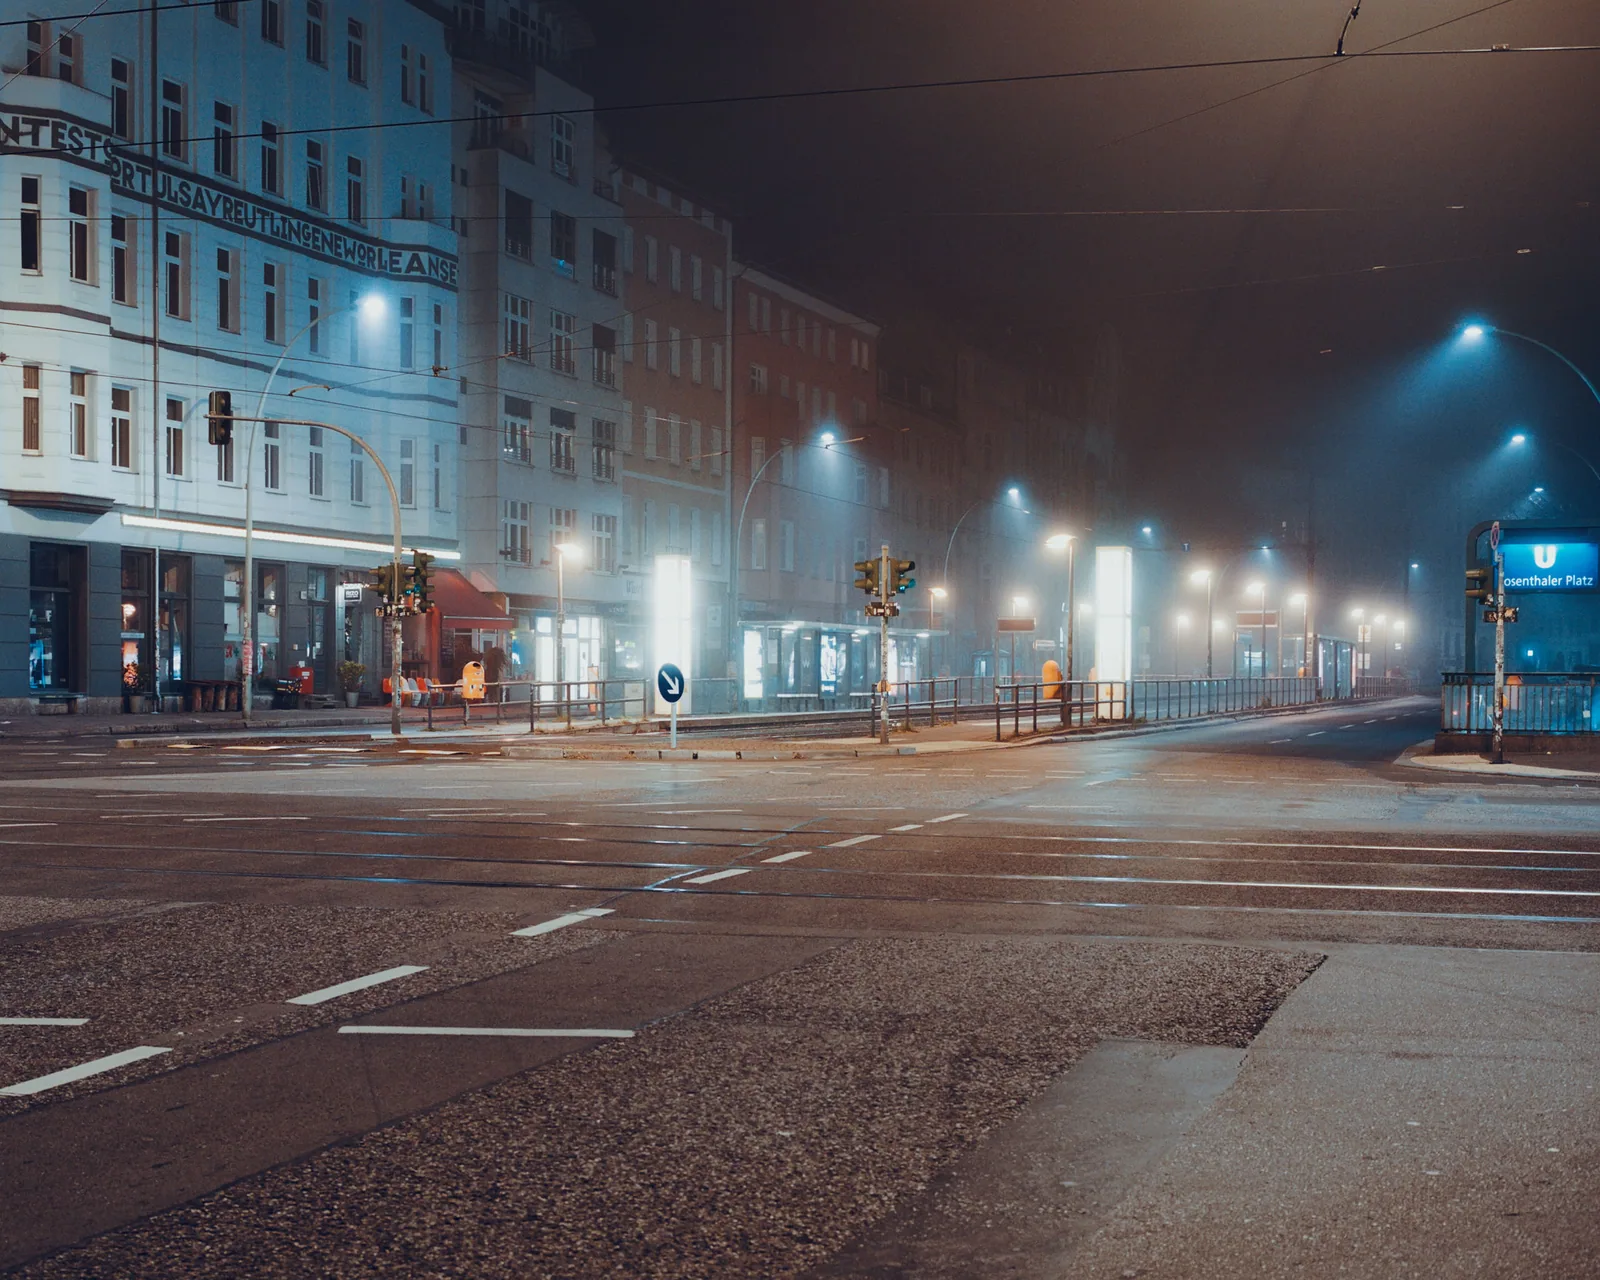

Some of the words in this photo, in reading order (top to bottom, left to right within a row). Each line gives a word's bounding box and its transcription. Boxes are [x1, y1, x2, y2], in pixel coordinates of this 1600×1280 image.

[1534, 545, 1557, 568] U
[1504, 575, 1562, 587] osenthaler
[1565, 575, 1593, 586] Platz
